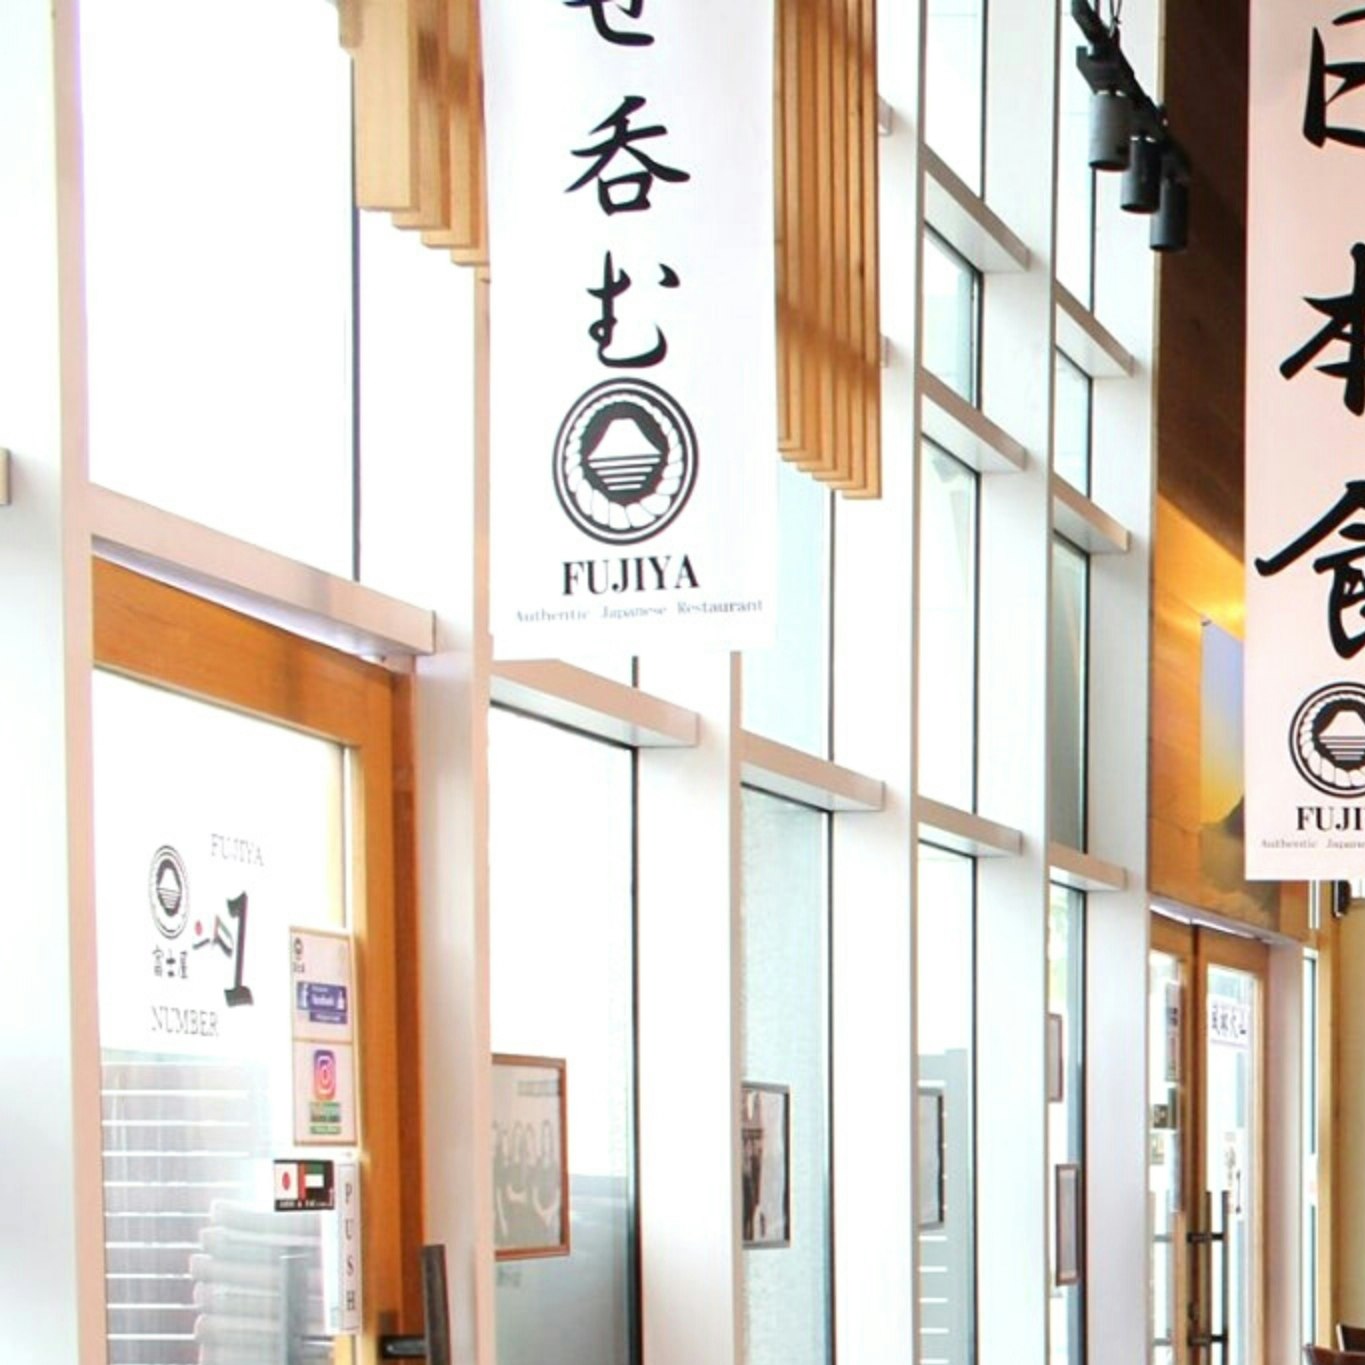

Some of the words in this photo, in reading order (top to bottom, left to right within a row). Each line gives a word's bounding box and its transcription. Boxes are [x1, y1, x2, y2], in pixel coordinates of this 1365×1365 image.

[563, 554, 700, 596] FUJIYA
[677, 599, 763, 616] Restaurant
[151, 1004, 219, 1038] NUMBER
[344, 1182, 356, 1313] PUSH
